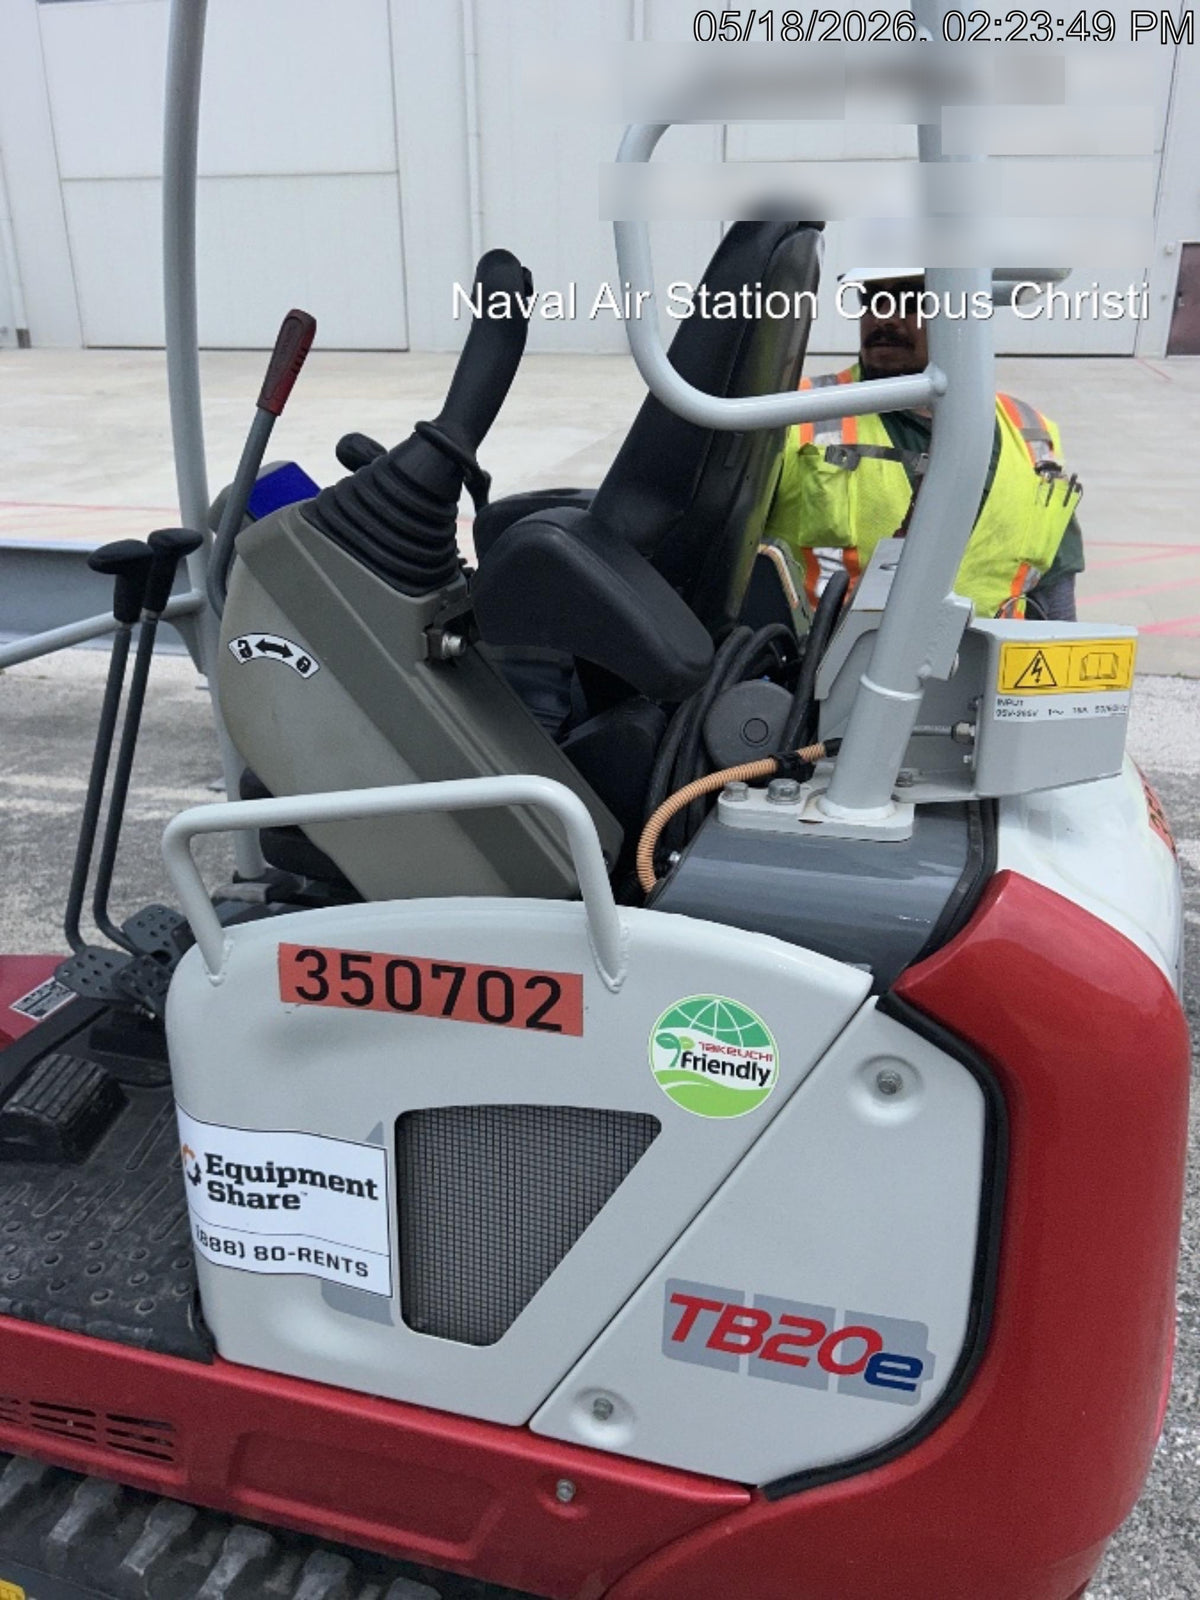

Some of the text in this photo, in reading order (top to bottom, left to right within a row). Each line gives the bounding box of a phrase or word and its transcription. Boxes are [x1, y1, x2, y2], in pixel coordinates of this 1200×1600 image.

[997, 698, 1024, 706] INPUT
[295, 949, 563, 1033] 350702
[681, 1050, 771, 1087] Friendly
[698, 1041, 773, 1062] TAKEUCHI
[204, 1153, 379, 1201] Equipment
[195, 1225, 369, 1278] (888) 80-RENTS
[670, 1293, 924, 1393] TB20e
